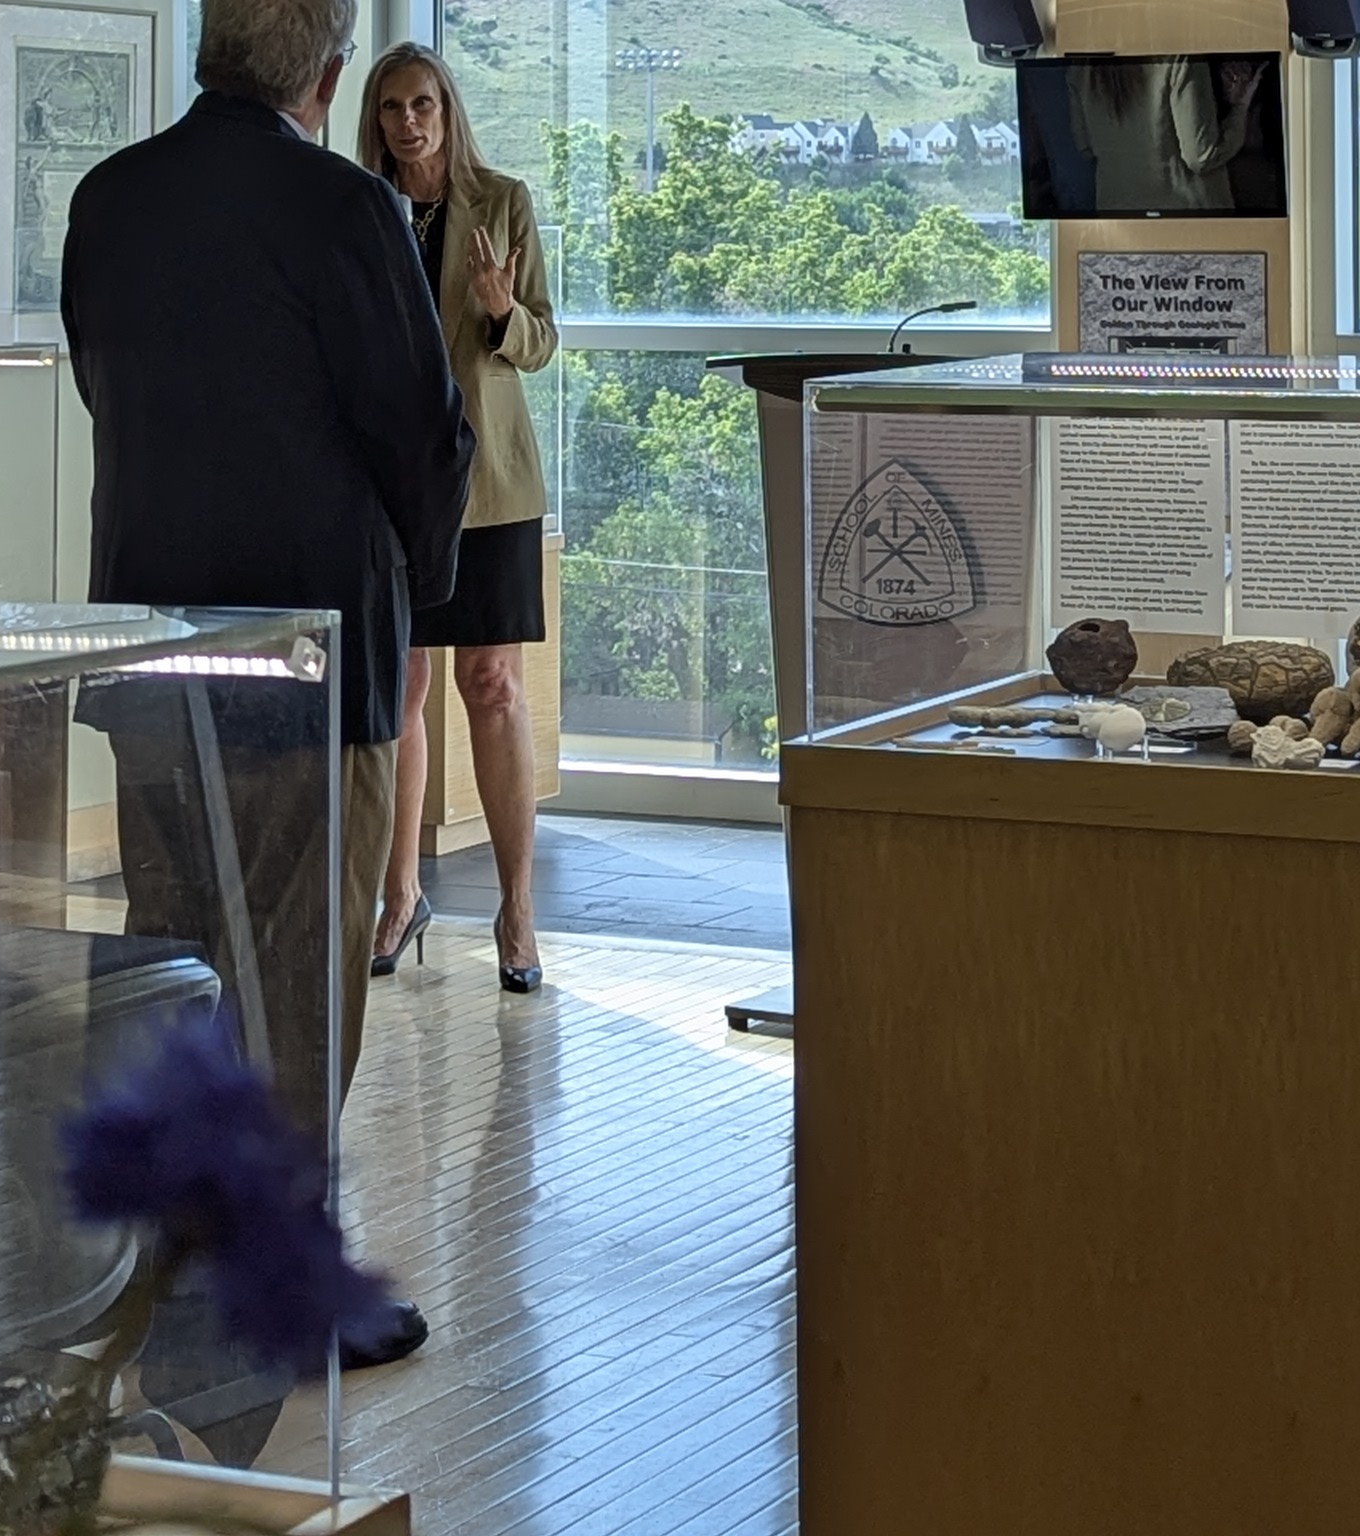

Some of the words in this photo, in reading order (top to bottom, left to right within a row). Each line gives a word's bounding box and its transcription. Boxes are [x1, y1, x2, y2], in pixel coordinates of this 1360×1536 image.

[1100, 274, 1135, 291] The
[1140, 274, 1188, 291] View
[1195, 275, 1246, 291] From
[1112, 296, 1147, 312] Our
[1154, 296, 1233, 313] Window
[1136, 319, 1176, 330] Through
[829, 492, 878, 572] SCHOOL
[885, 471, 907, 483] OF
[921, 498, 963, 563] MINES
[876, 579, 917, 595] 1874
[839, 595, 955, 621] COLORADO
